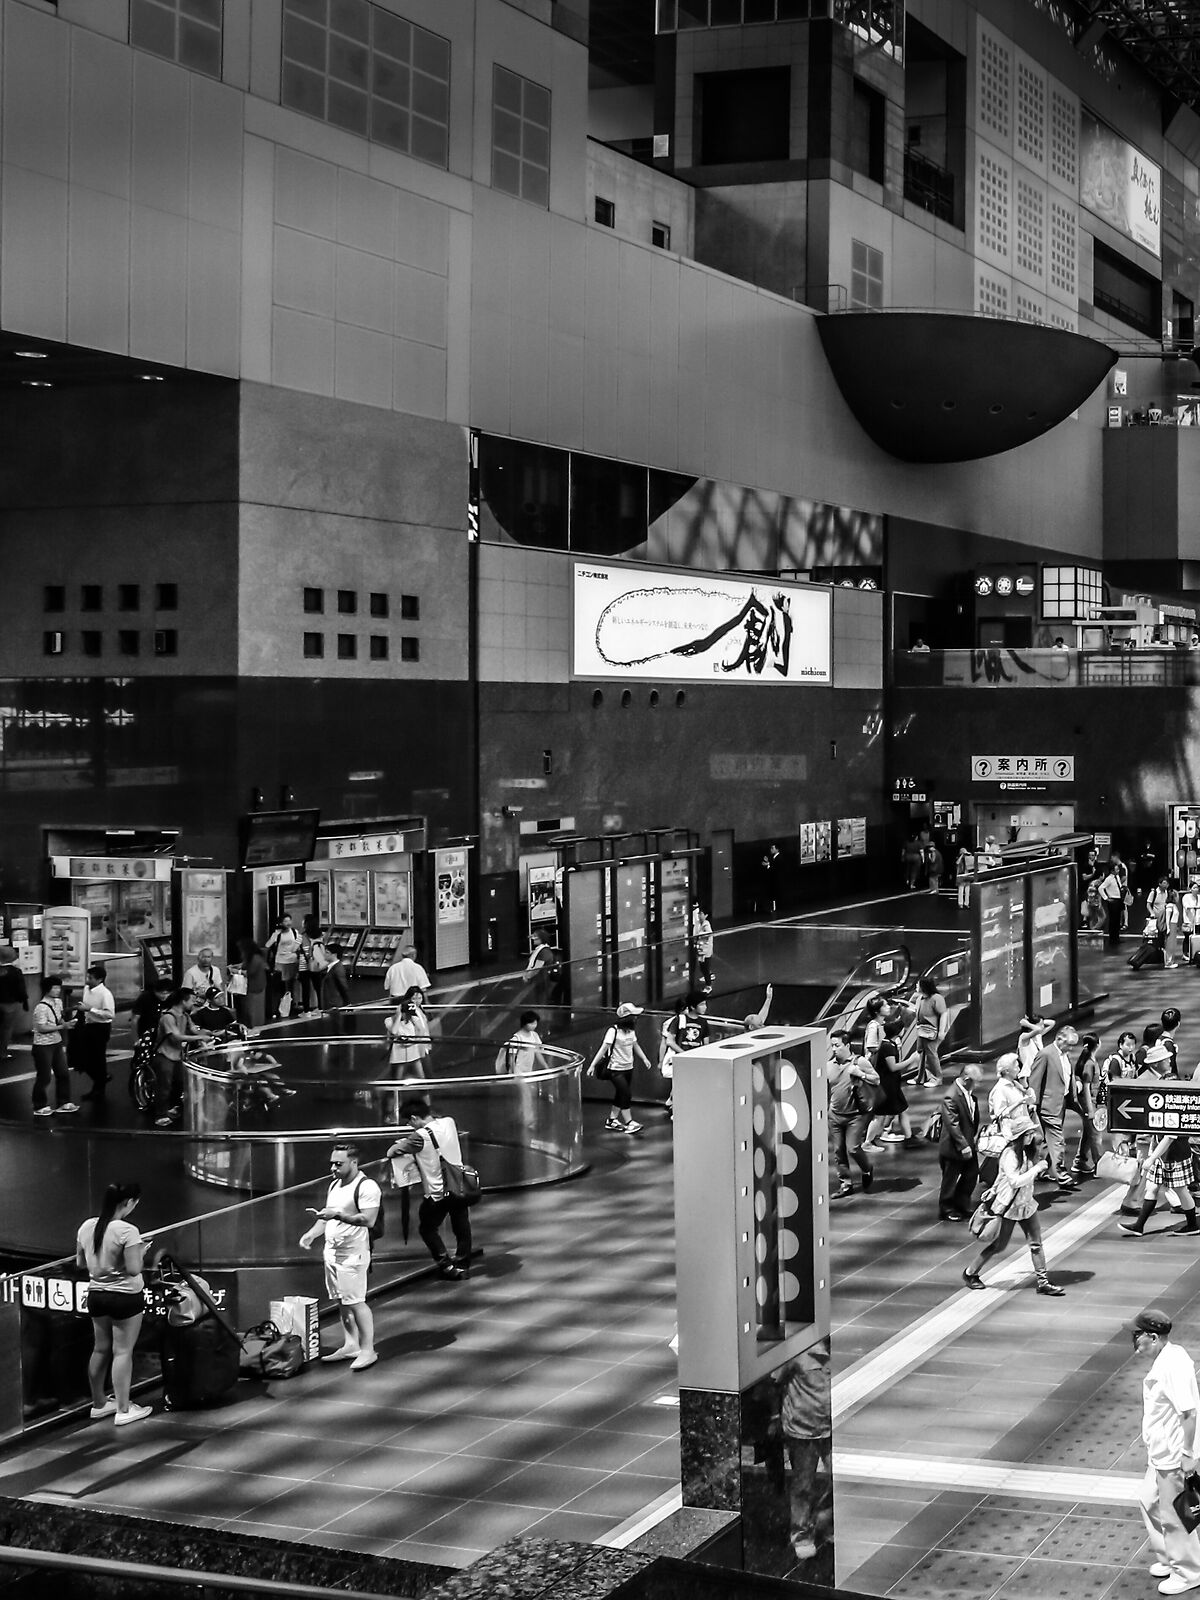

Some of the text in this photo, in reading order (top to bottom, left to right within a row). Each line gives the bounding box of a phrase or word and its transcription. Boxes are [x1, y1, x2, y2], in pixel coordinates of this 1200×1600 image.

[998, 758, 1047, 771] 案内所
[1165, 1103, 1187, 1112] Railway
